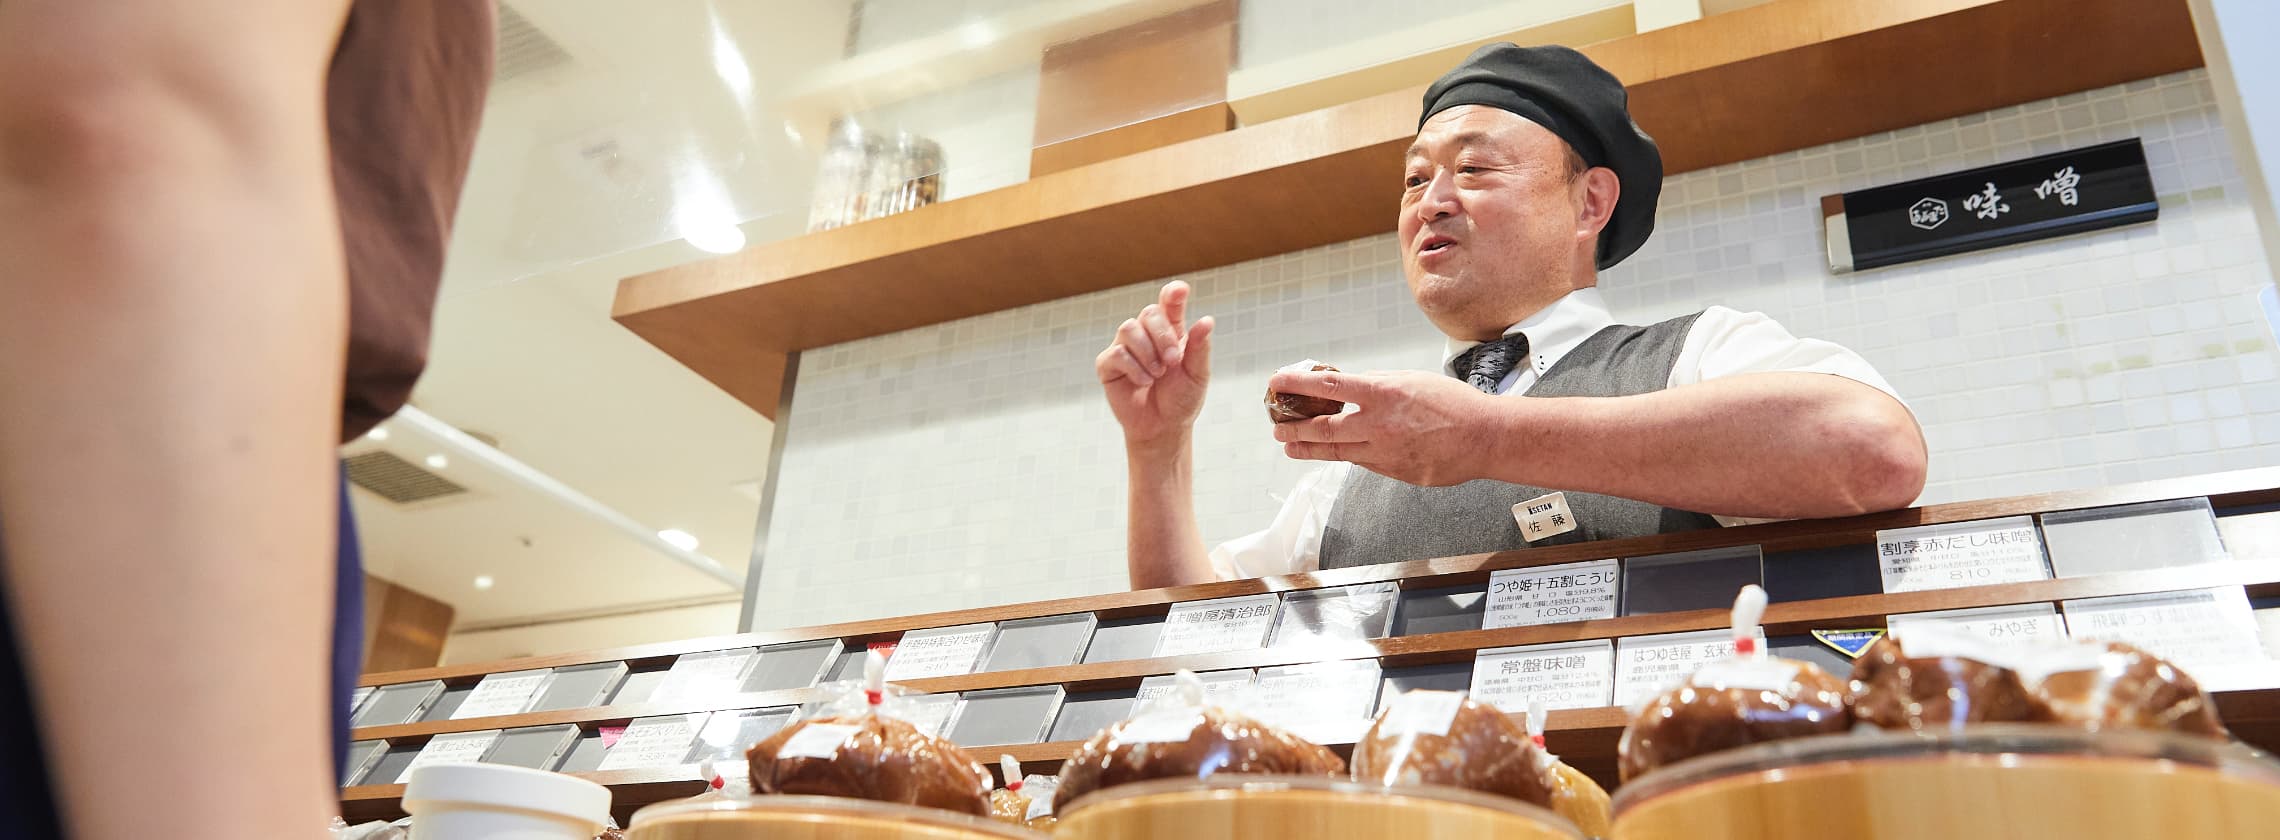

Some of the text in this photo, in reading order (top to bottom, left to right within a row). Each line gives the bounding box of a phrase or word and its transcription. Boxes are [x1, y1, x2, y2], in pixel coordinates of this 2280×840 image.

[1527, 503, 1553, 515] ISETAN
[1880, 528, 2033, 556] 割烹赤だし味噌
[1493, 571, 1616, 594] つや姫十五割こうじ
[1950, 568, 1991, 580] 810
[1988, 618, 2039, 638] みやぎ
[1634, 645, 1692, 663] はつゆき屋
[1501, 655, 1586, 675] 常盤味噌
